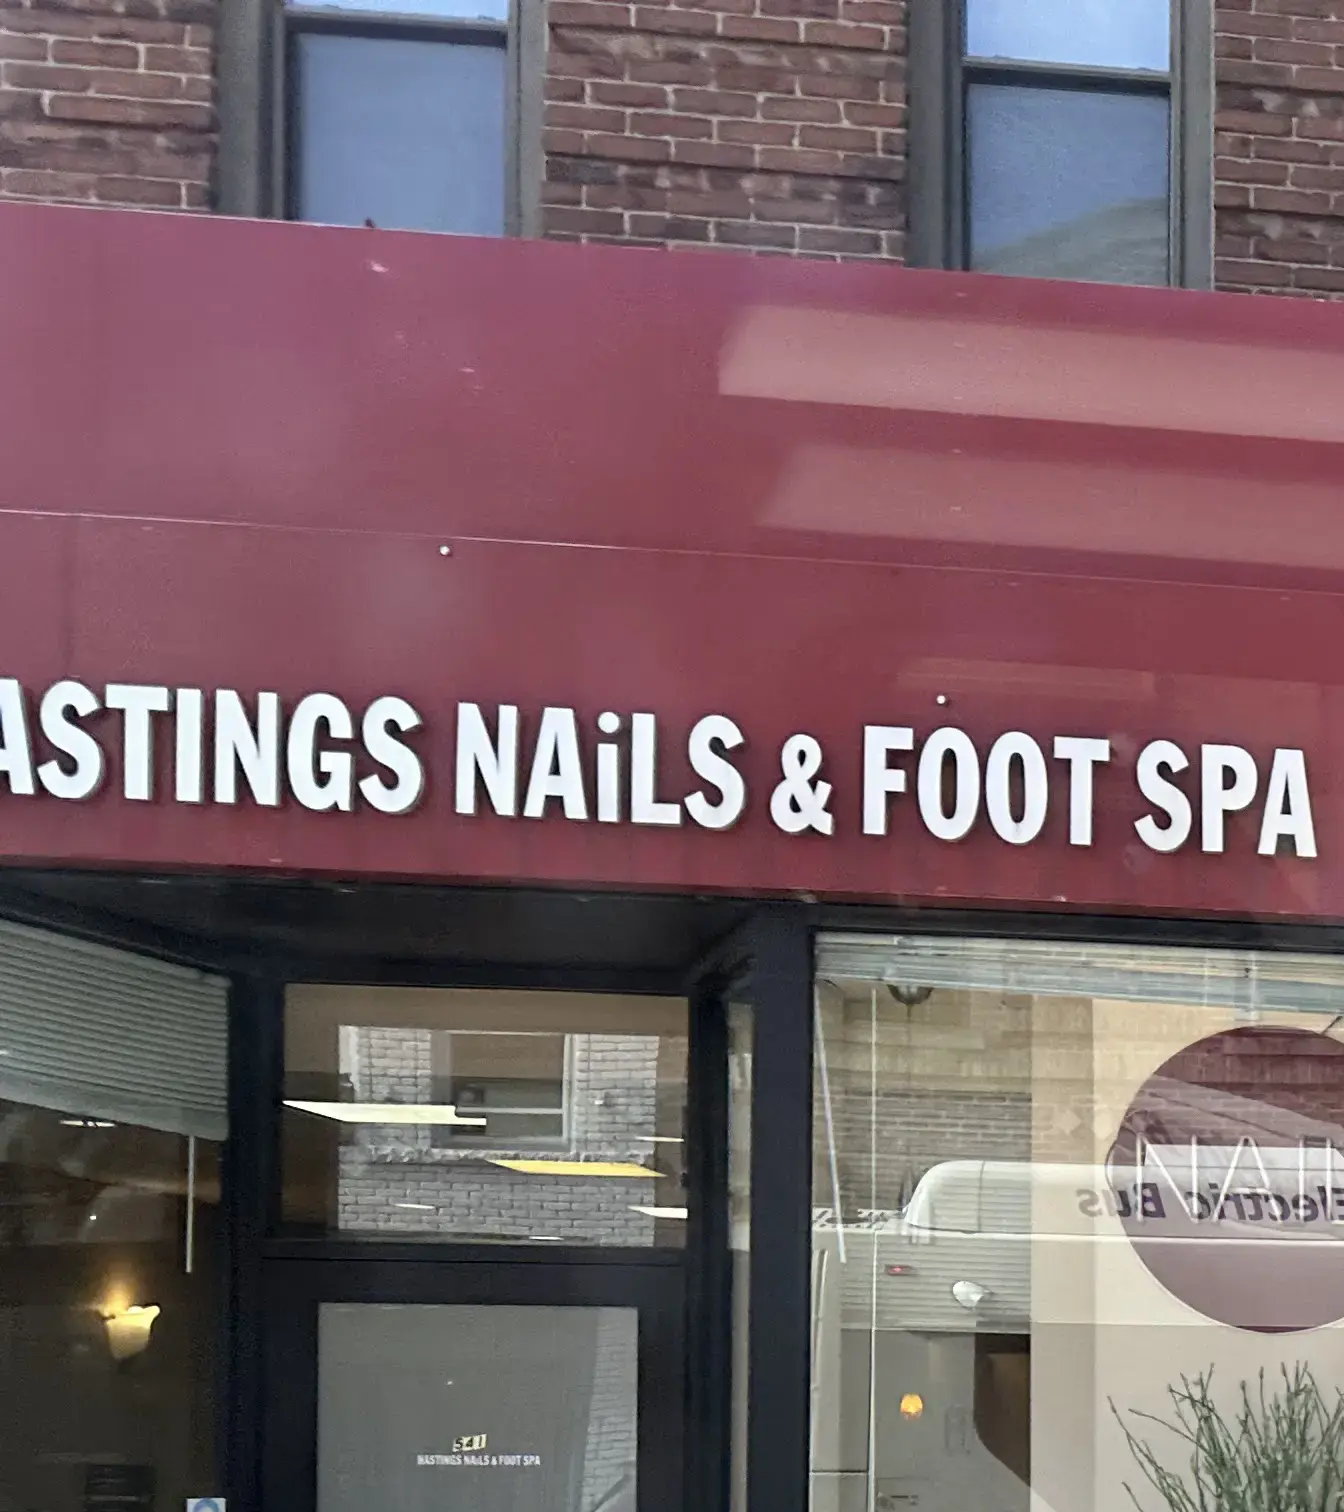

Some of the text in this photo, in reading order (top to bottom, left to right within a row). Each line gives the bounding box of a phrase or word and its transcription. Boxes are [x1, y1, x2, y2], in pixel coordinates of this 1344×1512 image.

[769, 733, 835, 837] &
[861, 724, 1111, 847] FOOT
[1133, 740, 1319, 859] SPA
